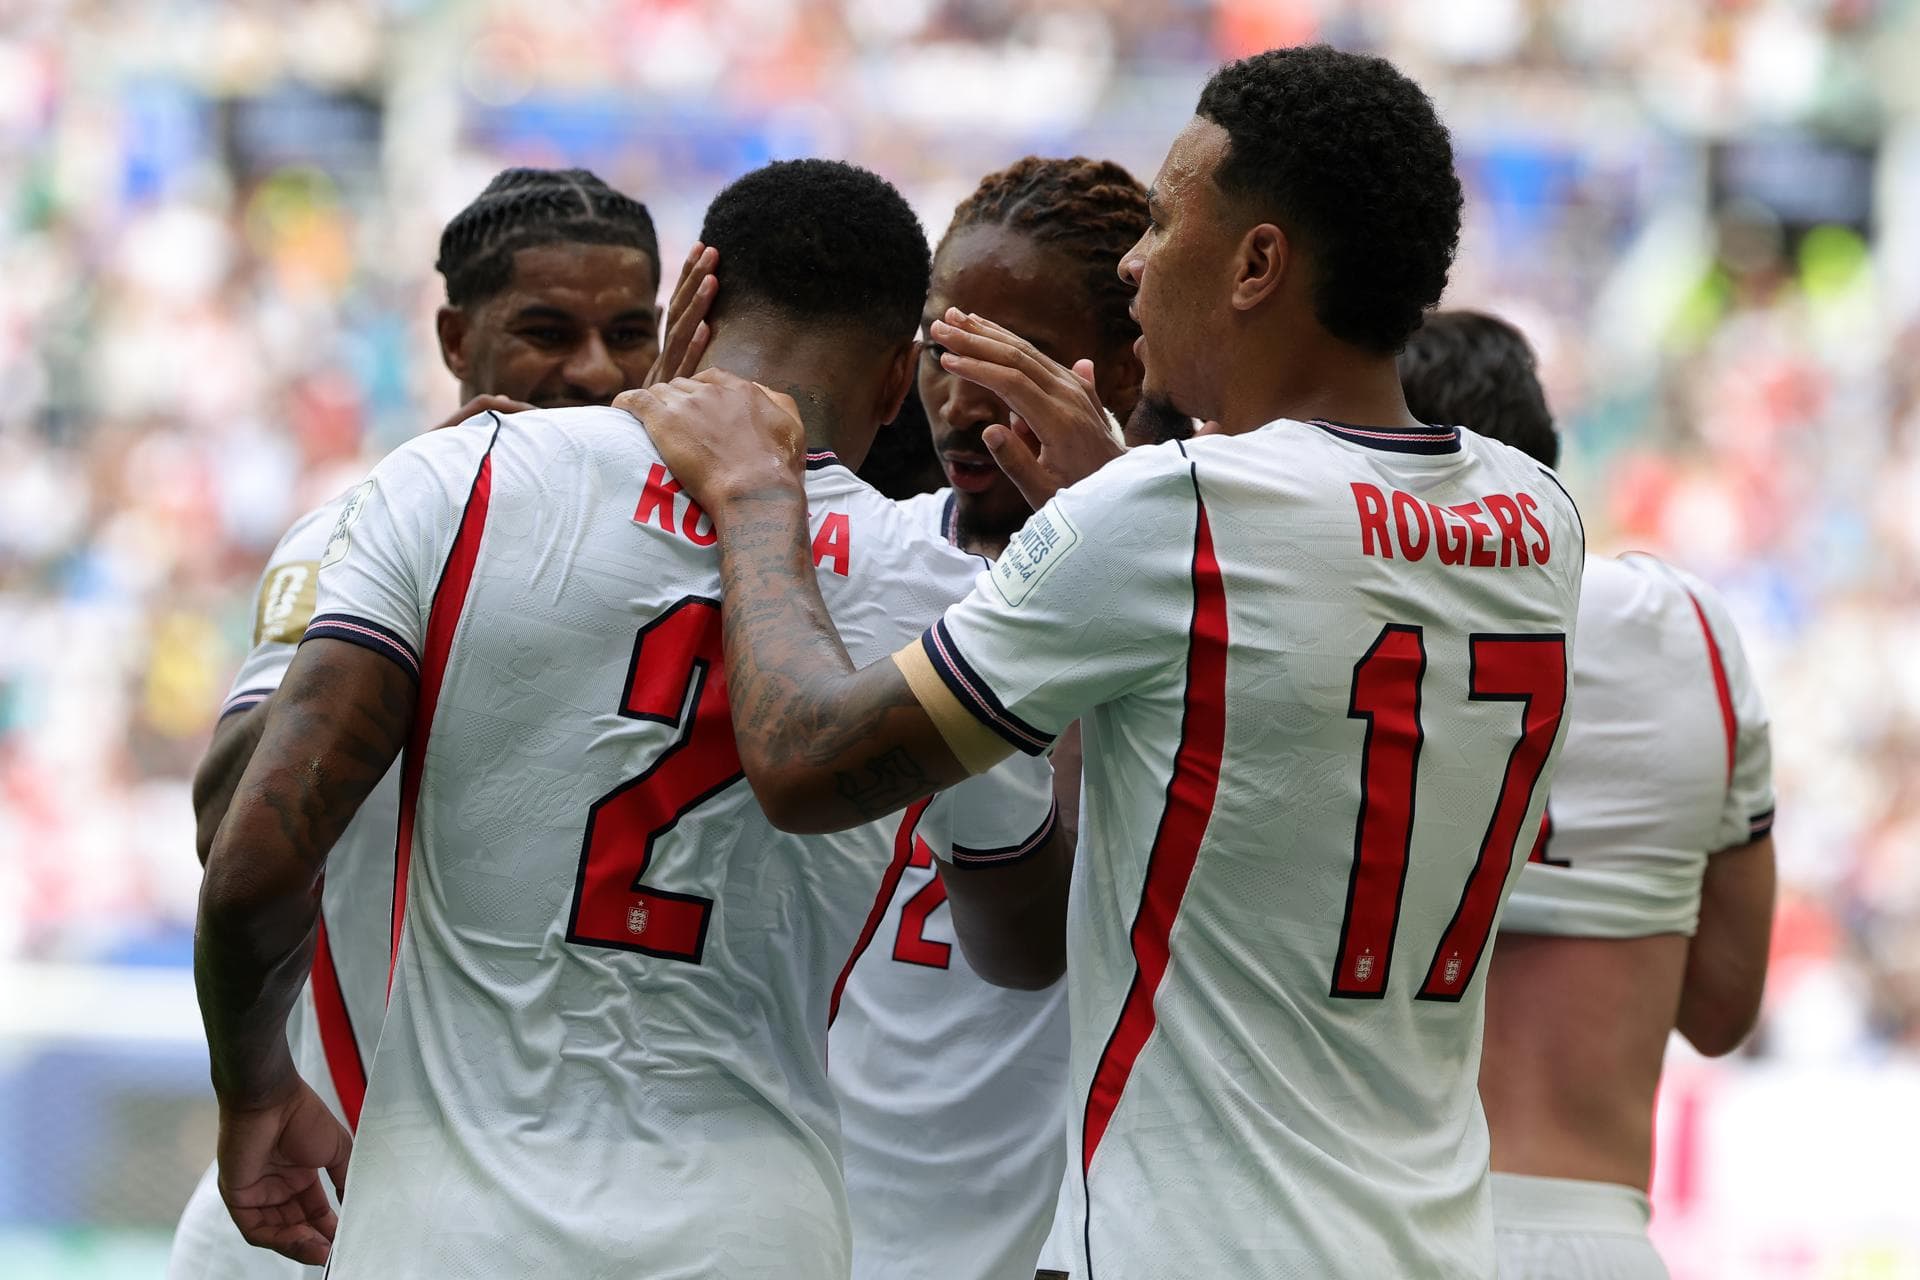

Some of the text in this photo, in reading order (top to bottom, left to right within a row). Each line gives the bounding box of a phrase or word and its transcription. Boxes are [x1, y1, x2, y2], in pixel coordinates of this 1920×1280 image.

[633, 463, 851, 577] KOA
[1350, 482, 1552, 568] ROGERS
[565, 594, 747, 965] 2
[1329, 622, 1567, 1002] 17
